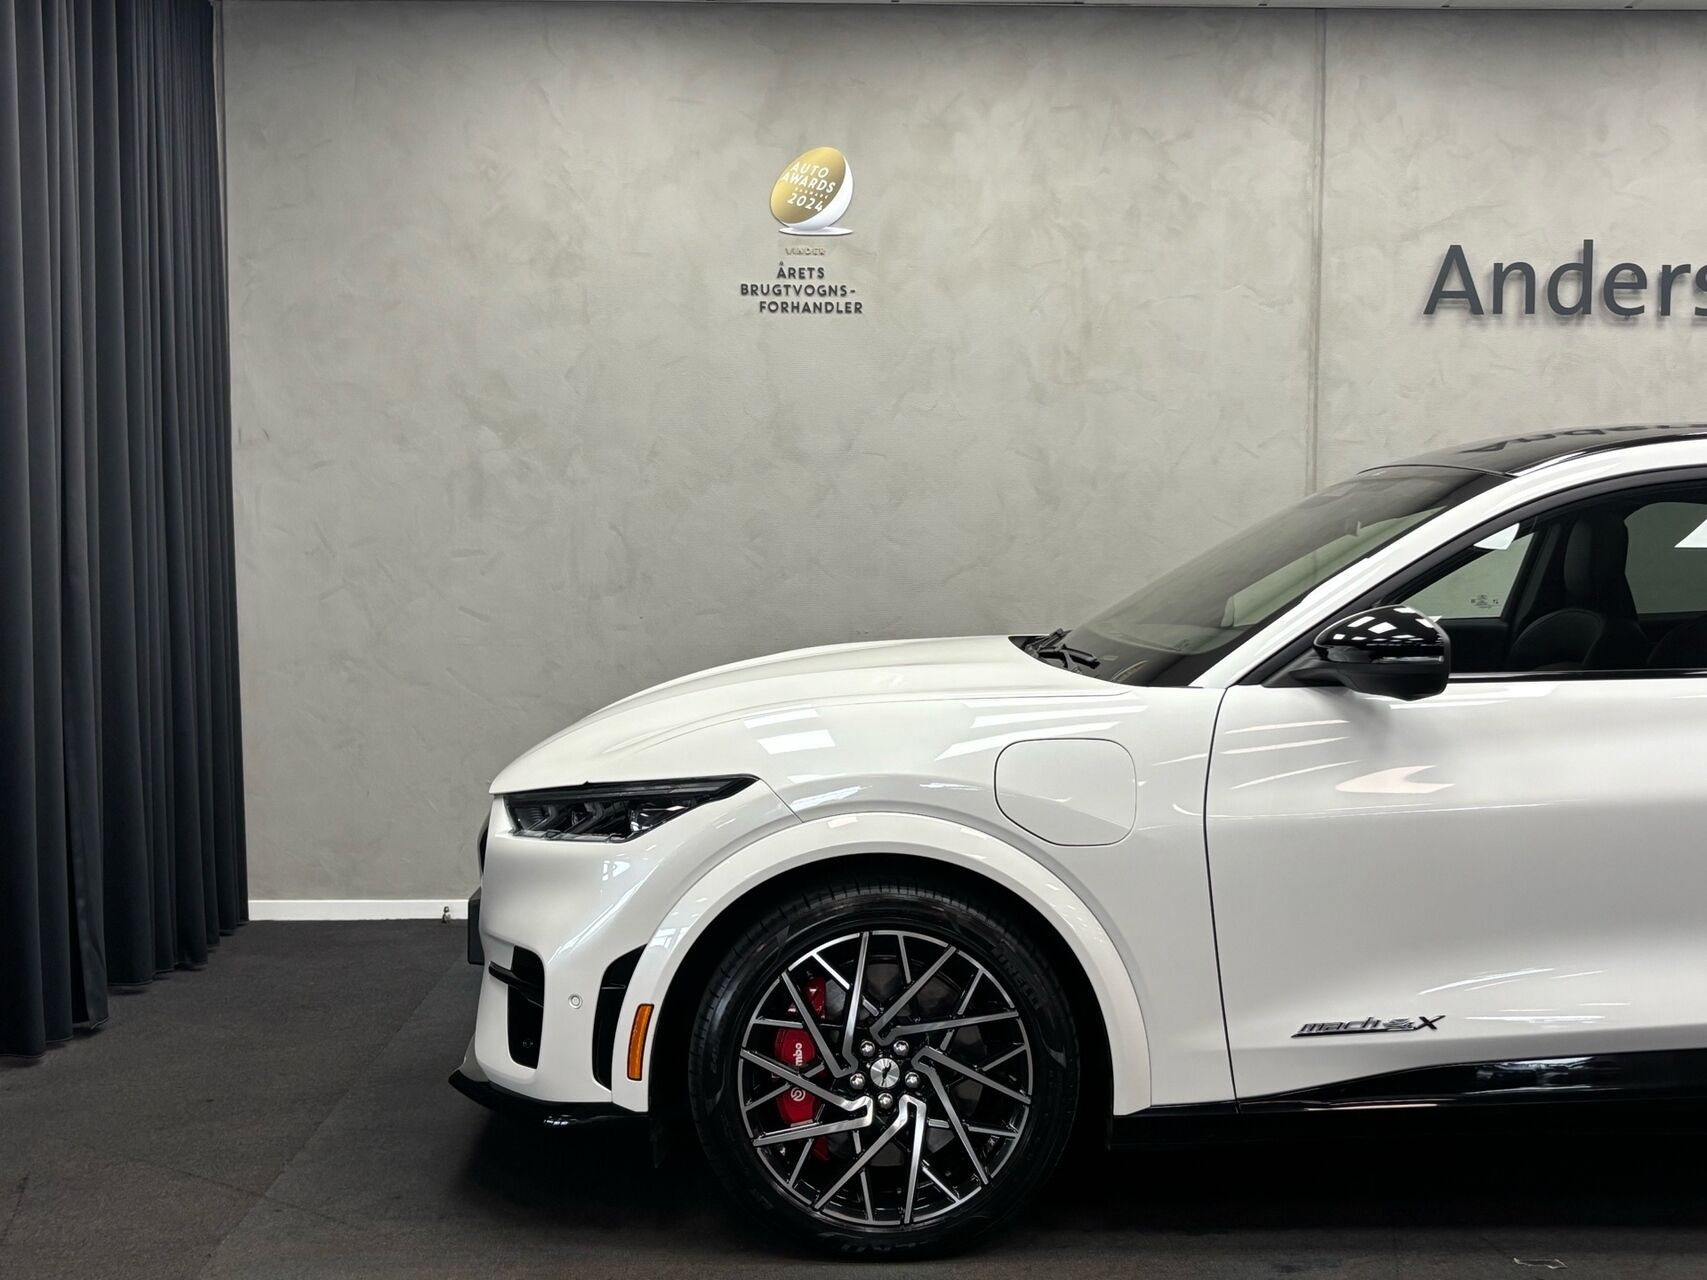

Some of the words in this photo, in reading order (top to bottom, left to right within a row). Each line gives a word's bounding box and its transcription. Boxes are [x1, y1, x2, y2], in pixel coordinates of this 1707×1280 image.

[791, 161, 829, 178] AUTO
[782, 171, 836, 193] AWARDS
[787, 192, 823, 212] 2024
[776, 261, 825, 279] ÅRETS
[740, 283, 856, 297] BRUGTVOGNS-
[759, 300, 863, 314] FORHANDLER
[793, 1042, 803, 1066] mbo
